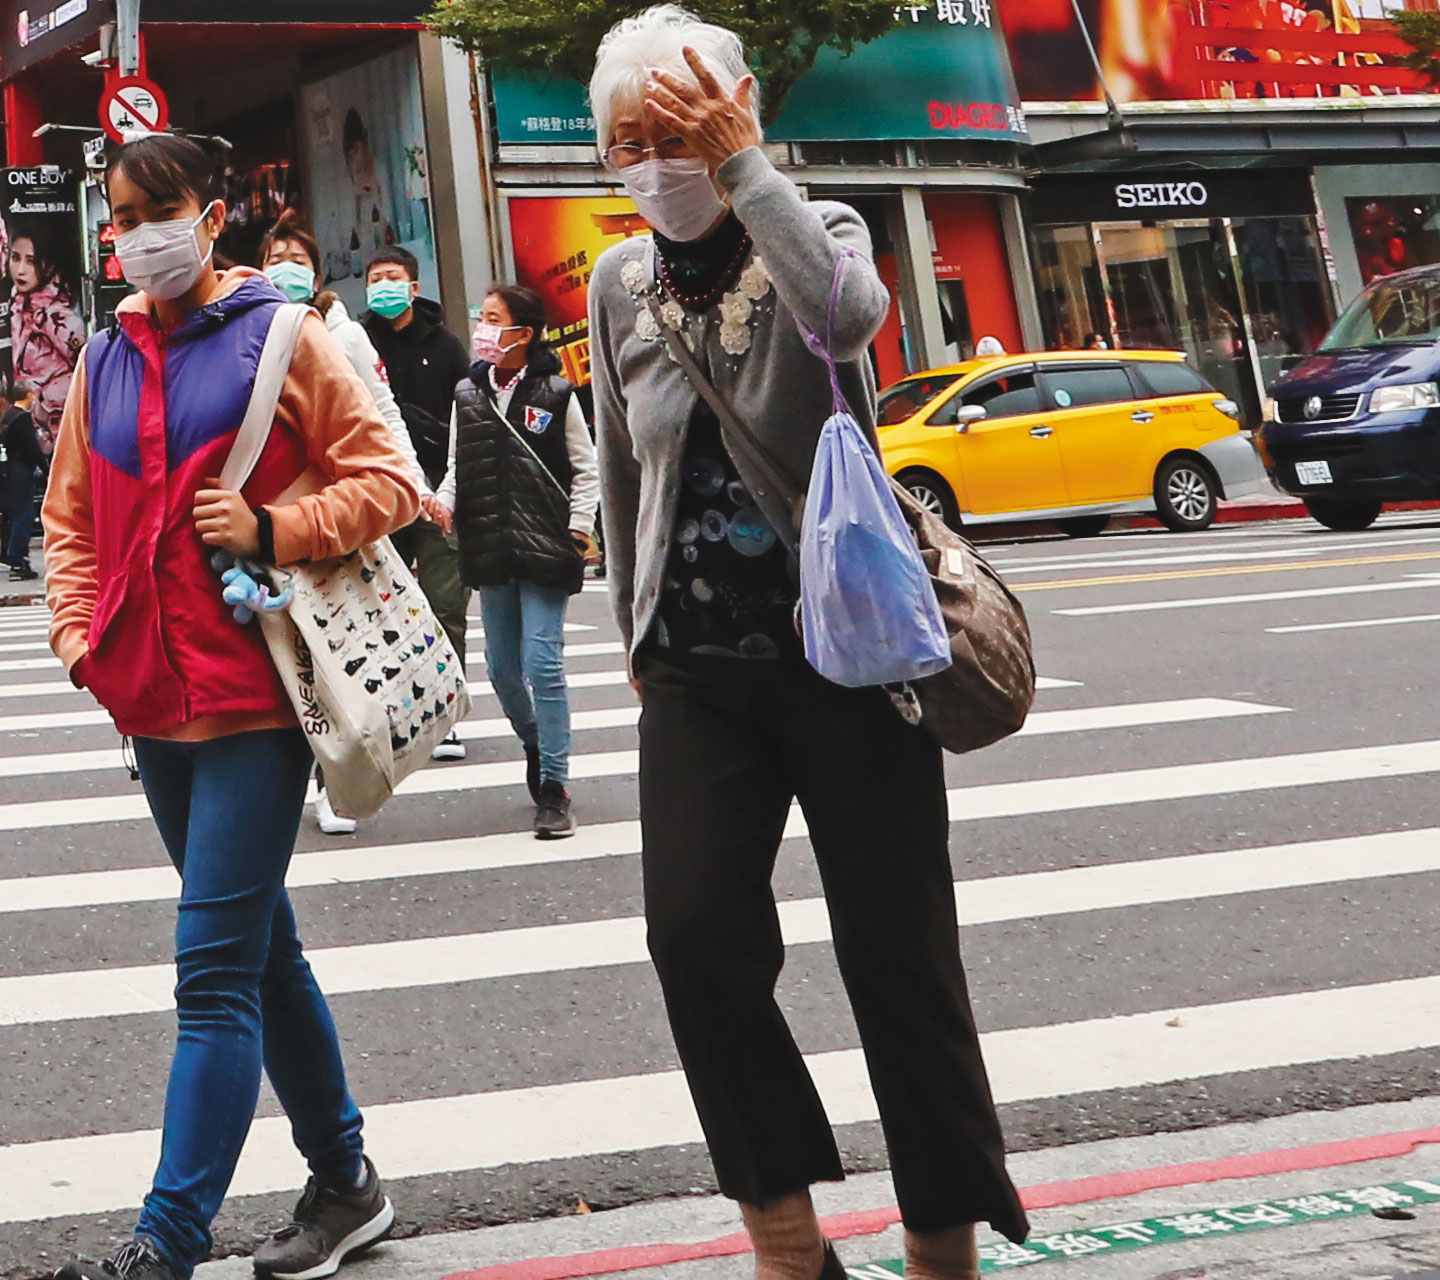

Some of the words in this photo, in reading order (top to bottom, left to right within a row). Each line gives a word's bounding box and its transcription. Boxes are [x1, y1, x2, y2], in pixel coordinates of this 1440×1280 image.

[927, 102, 1007, 131] DIAGEO
[7, 171, 37, 186] ONE
[39, 170, 66, 185] BOY
[1115, 182, 1208, 208] SEIKO
[294, 628, 330, 736] SNEAKE
